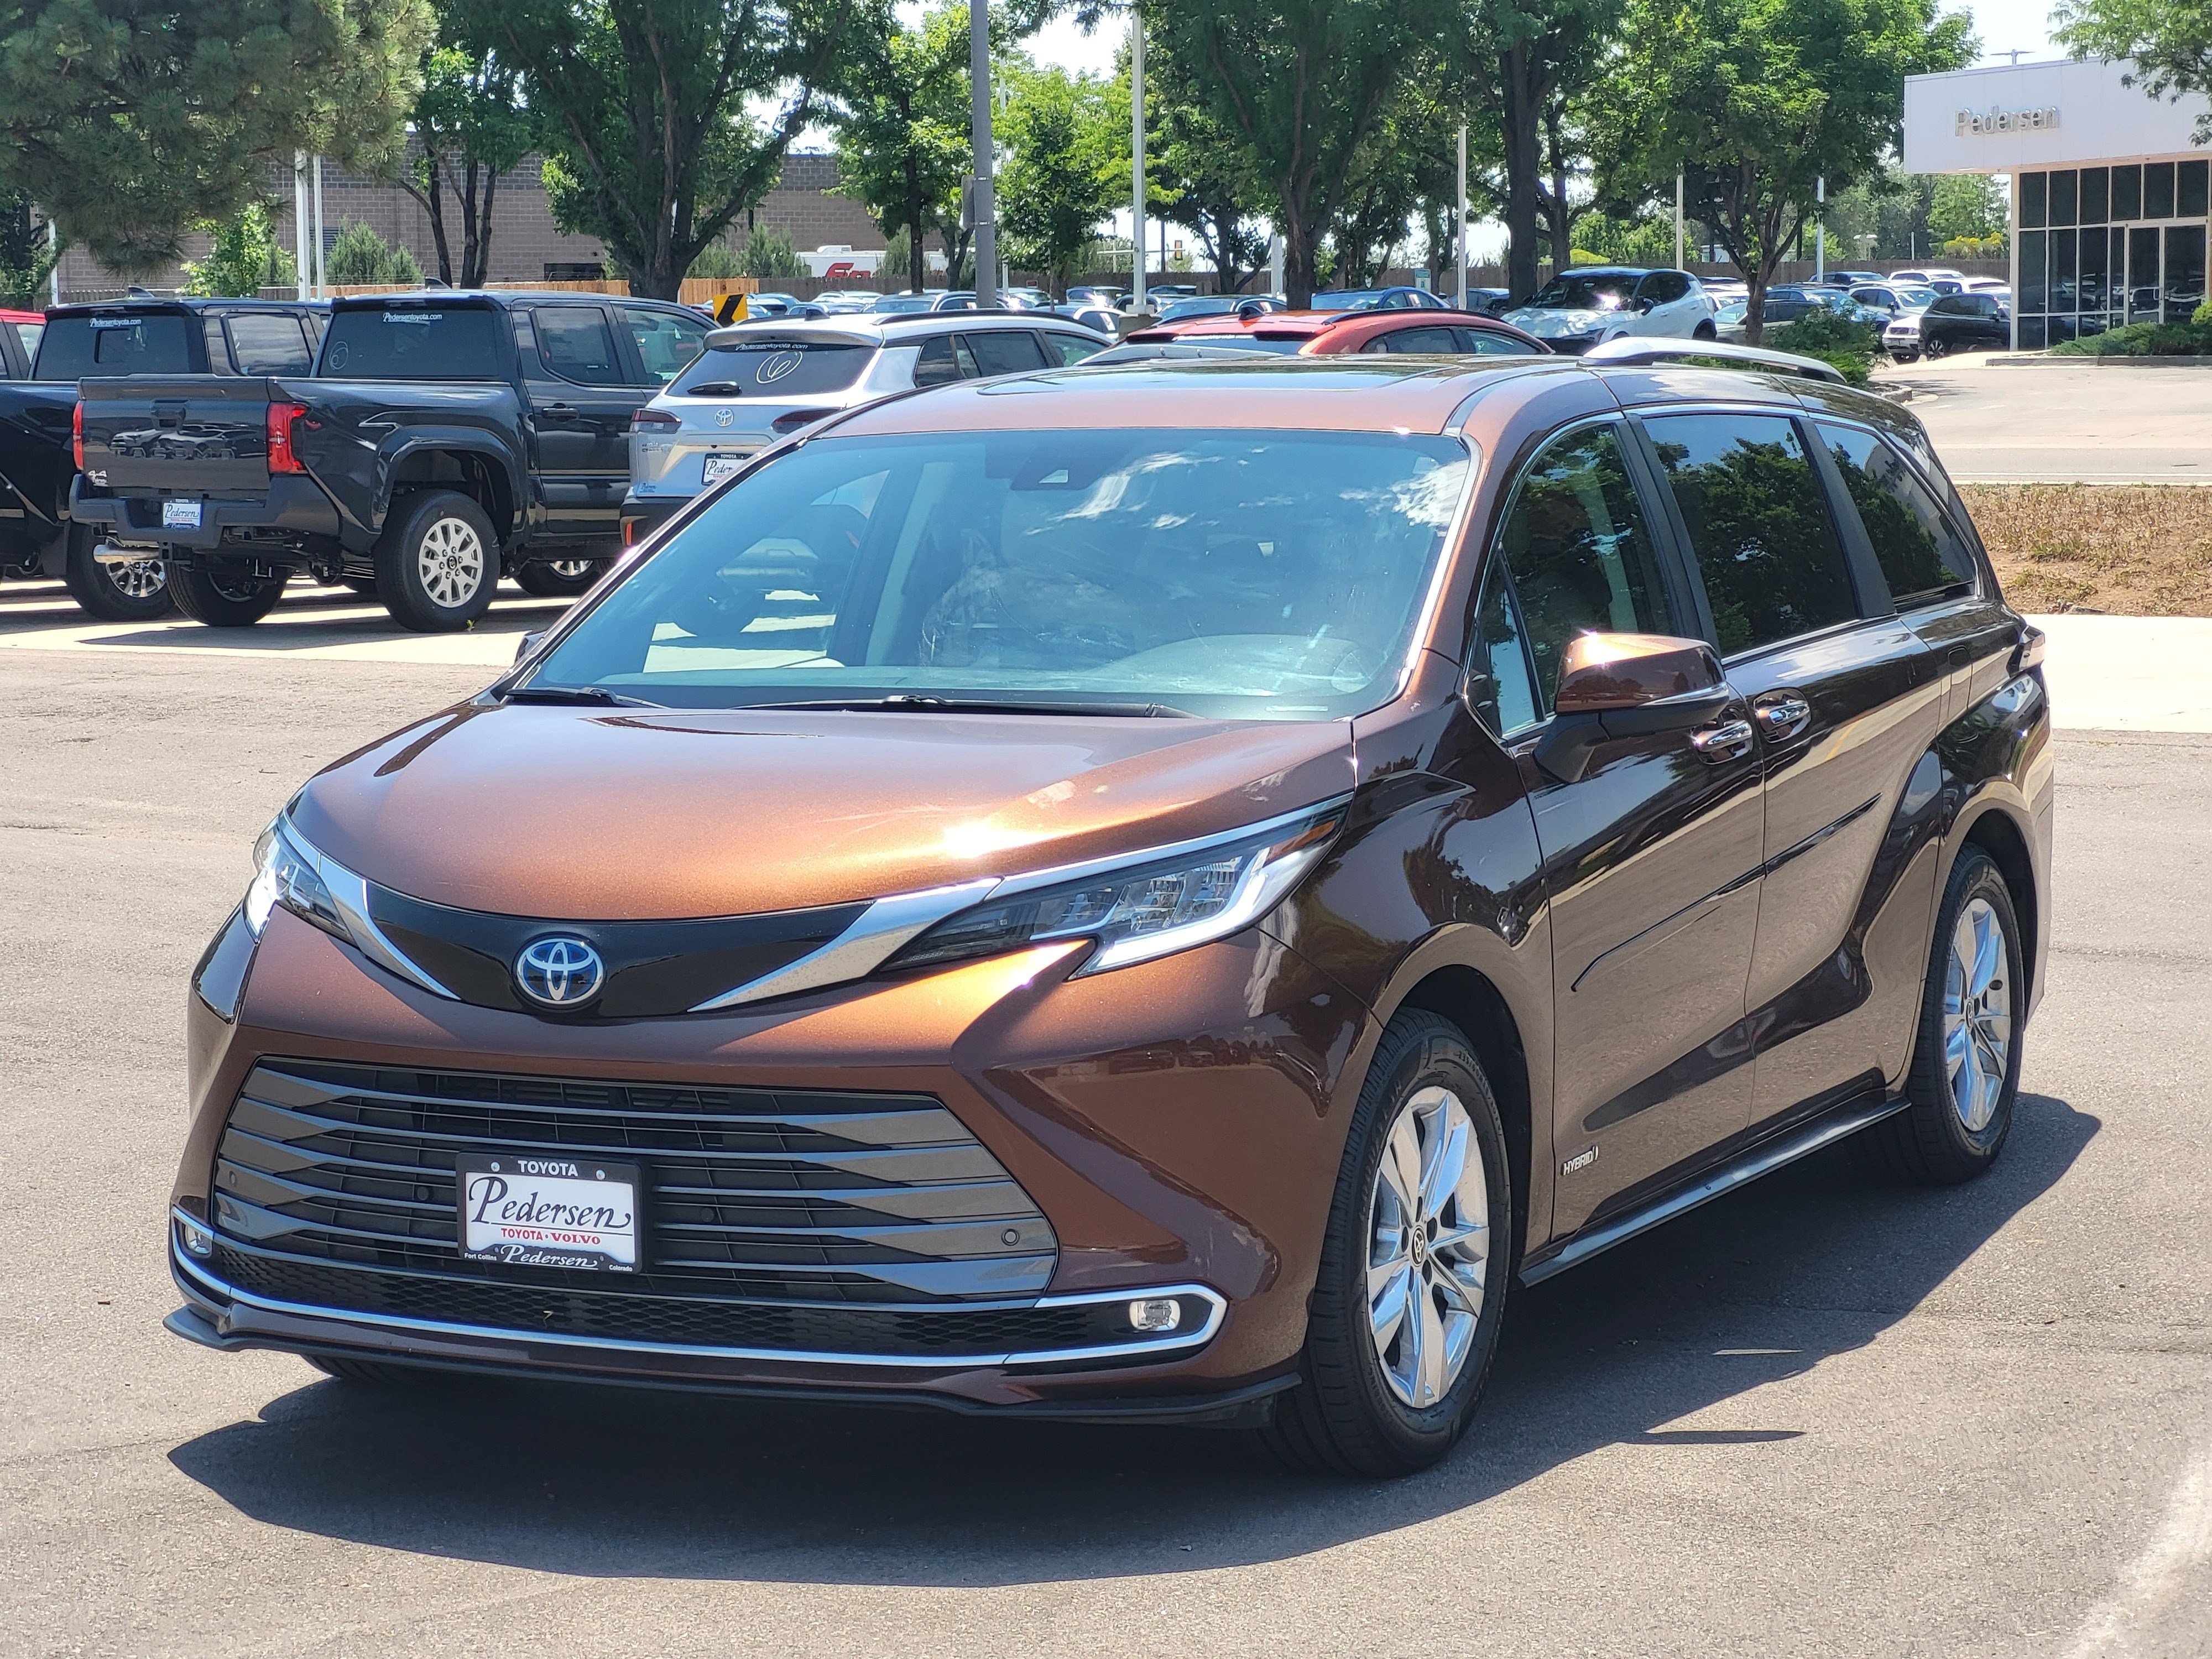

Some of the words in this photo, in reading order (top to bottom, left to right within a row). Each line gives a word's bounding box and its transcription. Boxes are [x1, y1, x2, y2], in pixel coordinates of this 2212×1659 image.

[1954, 105, 2060, 136] Pedersen
[382, 312, 442, 322] Pedersentoyota.com
[706, 460, 733, 475] Peder
[518, 1160, 578, 1177] TOYOTA
[1563, 1150, 1593, 1176] HYBRID
[469, 1176, 631, 1229] Pedersen
[501, 1228, 543, 1241] TOYOTA
[550, 1232, 601, 1245] VOLVO
[500, 1244, 598, 1268] Pedersen
